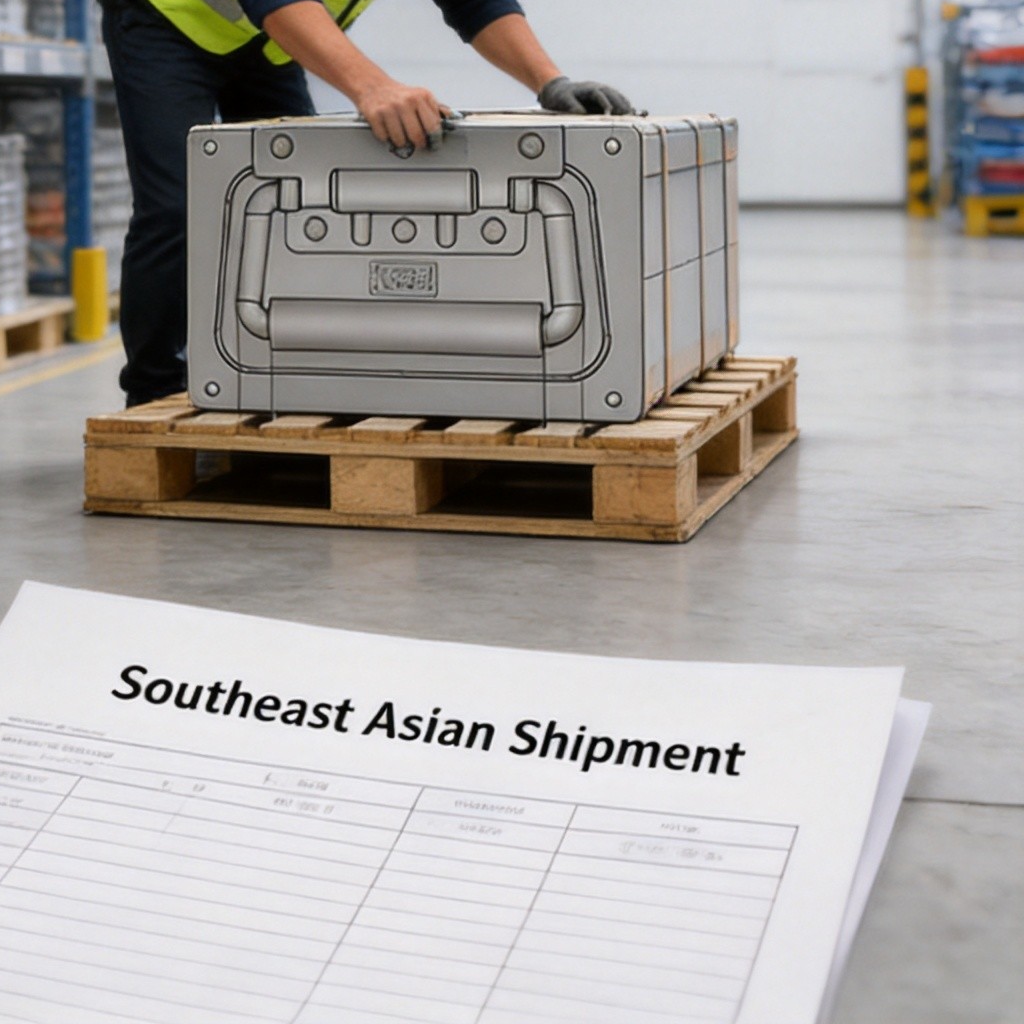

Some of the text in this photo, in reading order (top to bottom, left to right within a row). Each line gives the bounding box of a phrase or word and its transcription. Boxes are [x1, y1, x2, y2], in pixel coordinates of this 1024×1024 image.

[111, 665, 746, 777] Southeast Asian Shipment
